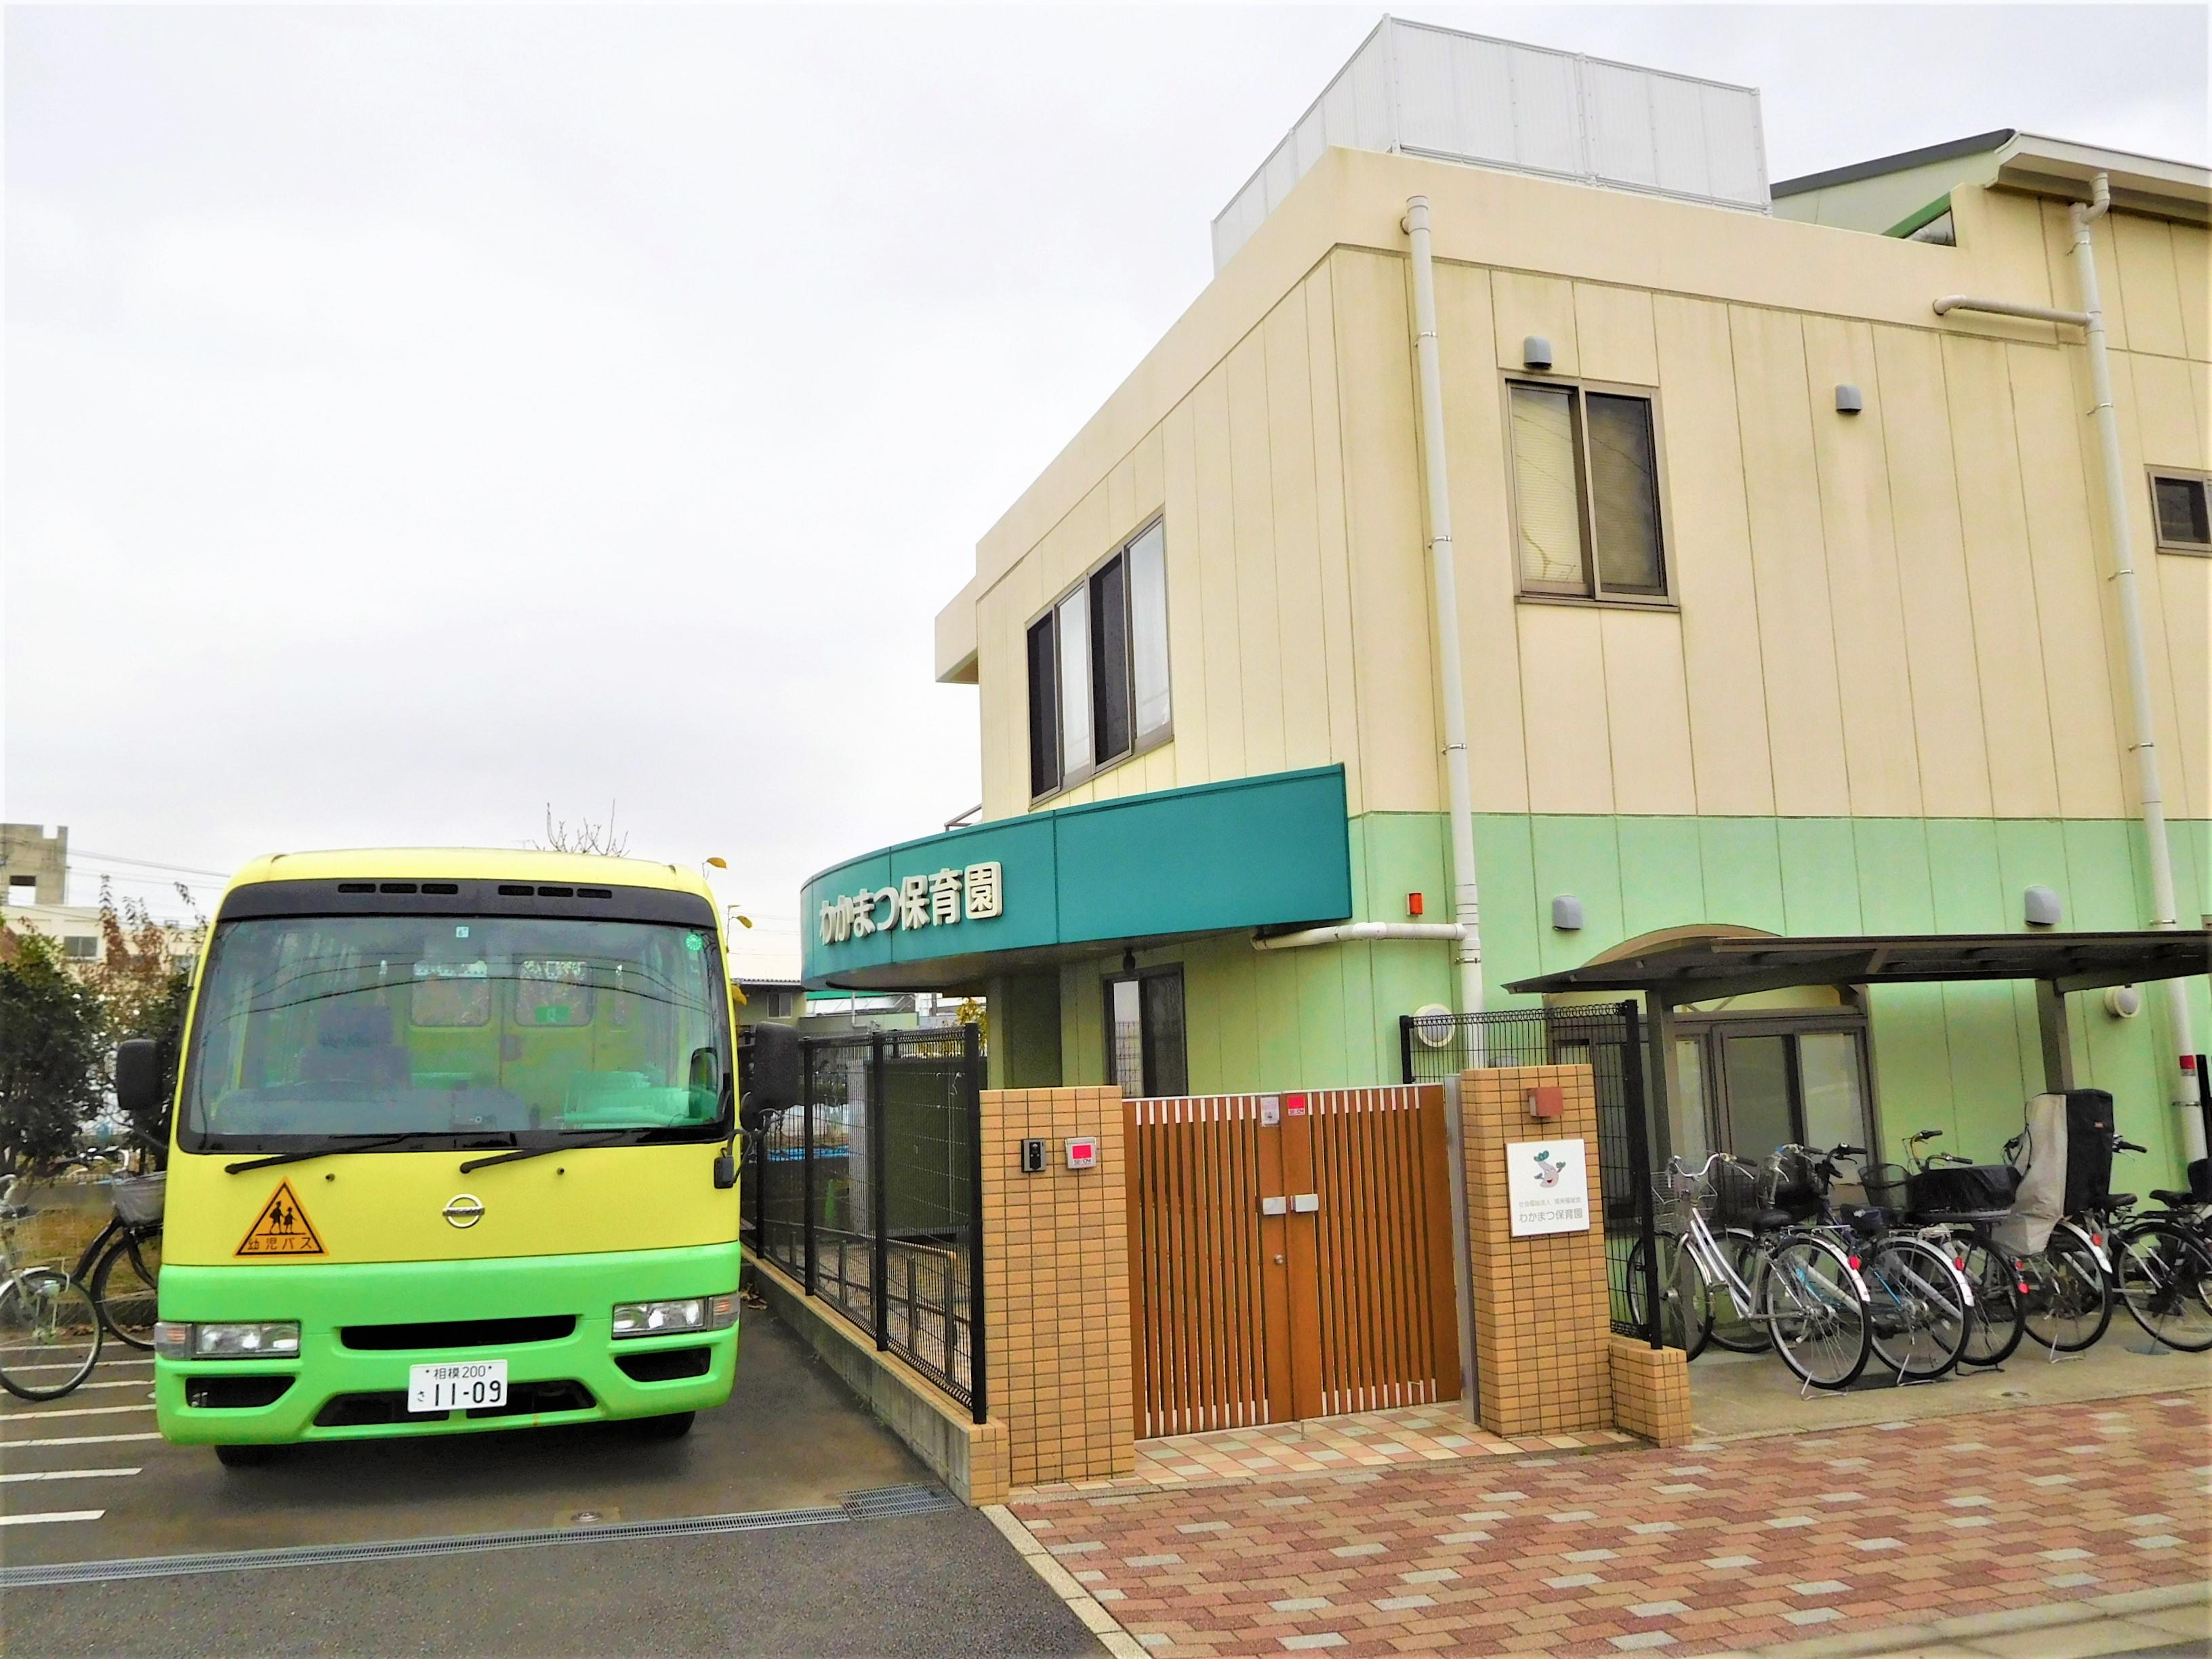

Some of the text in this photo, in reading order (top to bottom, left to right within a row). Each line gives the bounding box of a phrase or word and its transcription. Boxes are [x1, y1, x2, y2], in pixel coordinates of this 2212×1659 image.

[819, 861, 1003, 946] わかまつ保育園
[1519, 1208, 1583, 1223] わかまつ保育園
[248, 1237, 312, 1250] 幼児バス
[435, 1380, 501, 1407] 11-09
